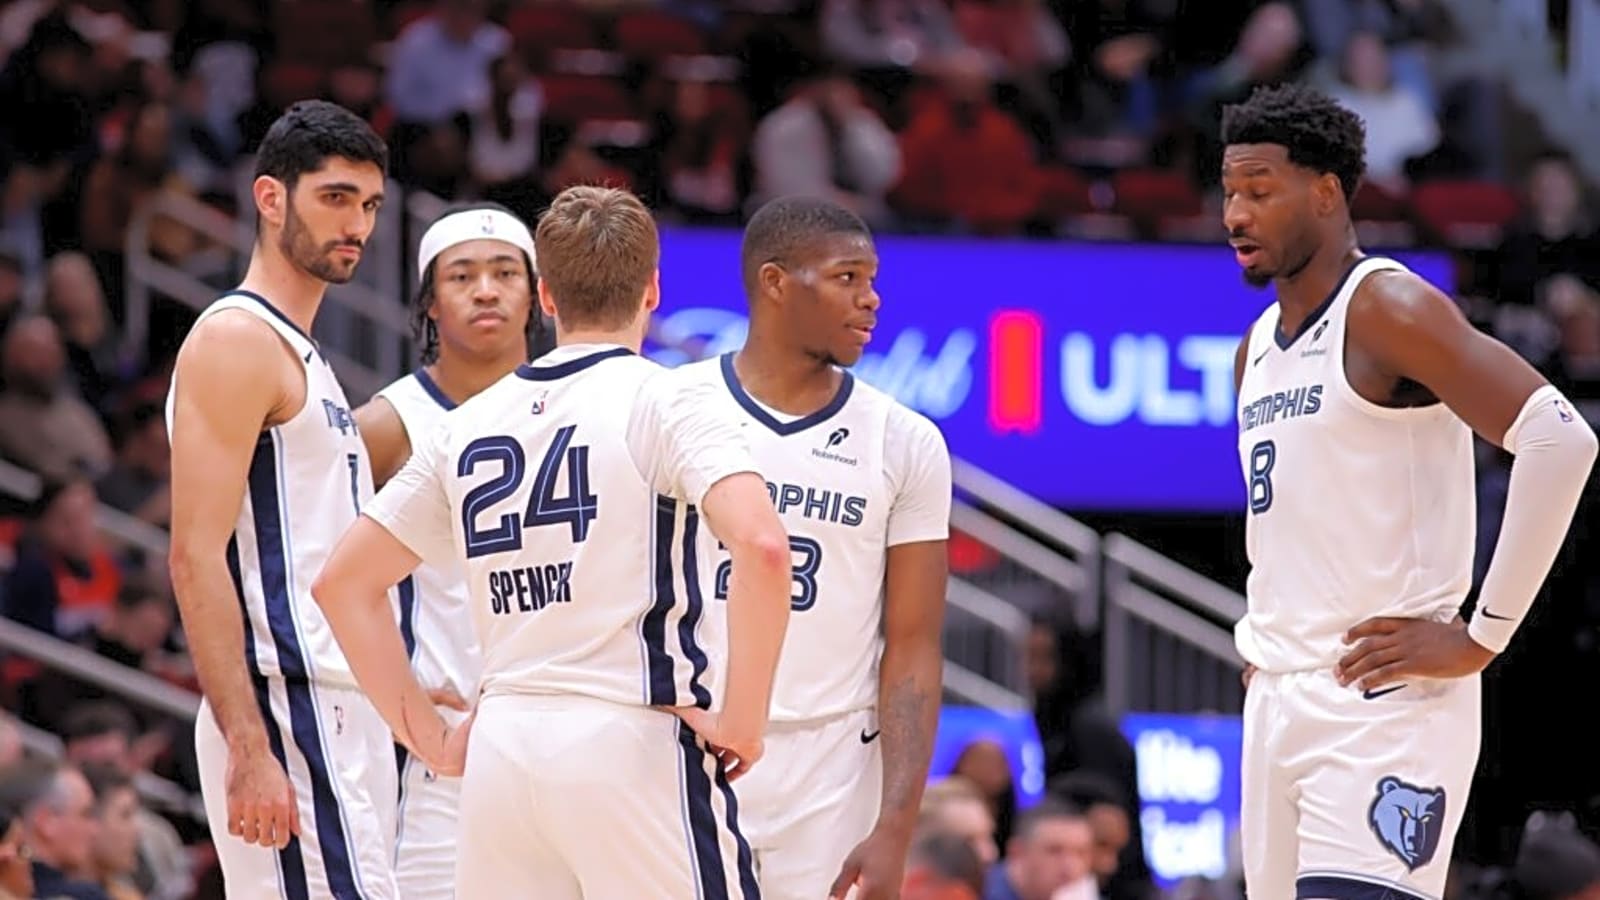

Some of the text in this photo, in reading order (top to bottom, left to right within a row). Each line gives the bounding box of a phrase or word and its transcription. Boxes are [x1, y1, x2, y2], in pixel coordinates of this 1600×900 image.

[457, 424, 597, 559] 24
[765, 481, 867, 527] PHIS
[1249, 440, 1275, 515] 8
[489, 560, 573, 614] SPENCR
